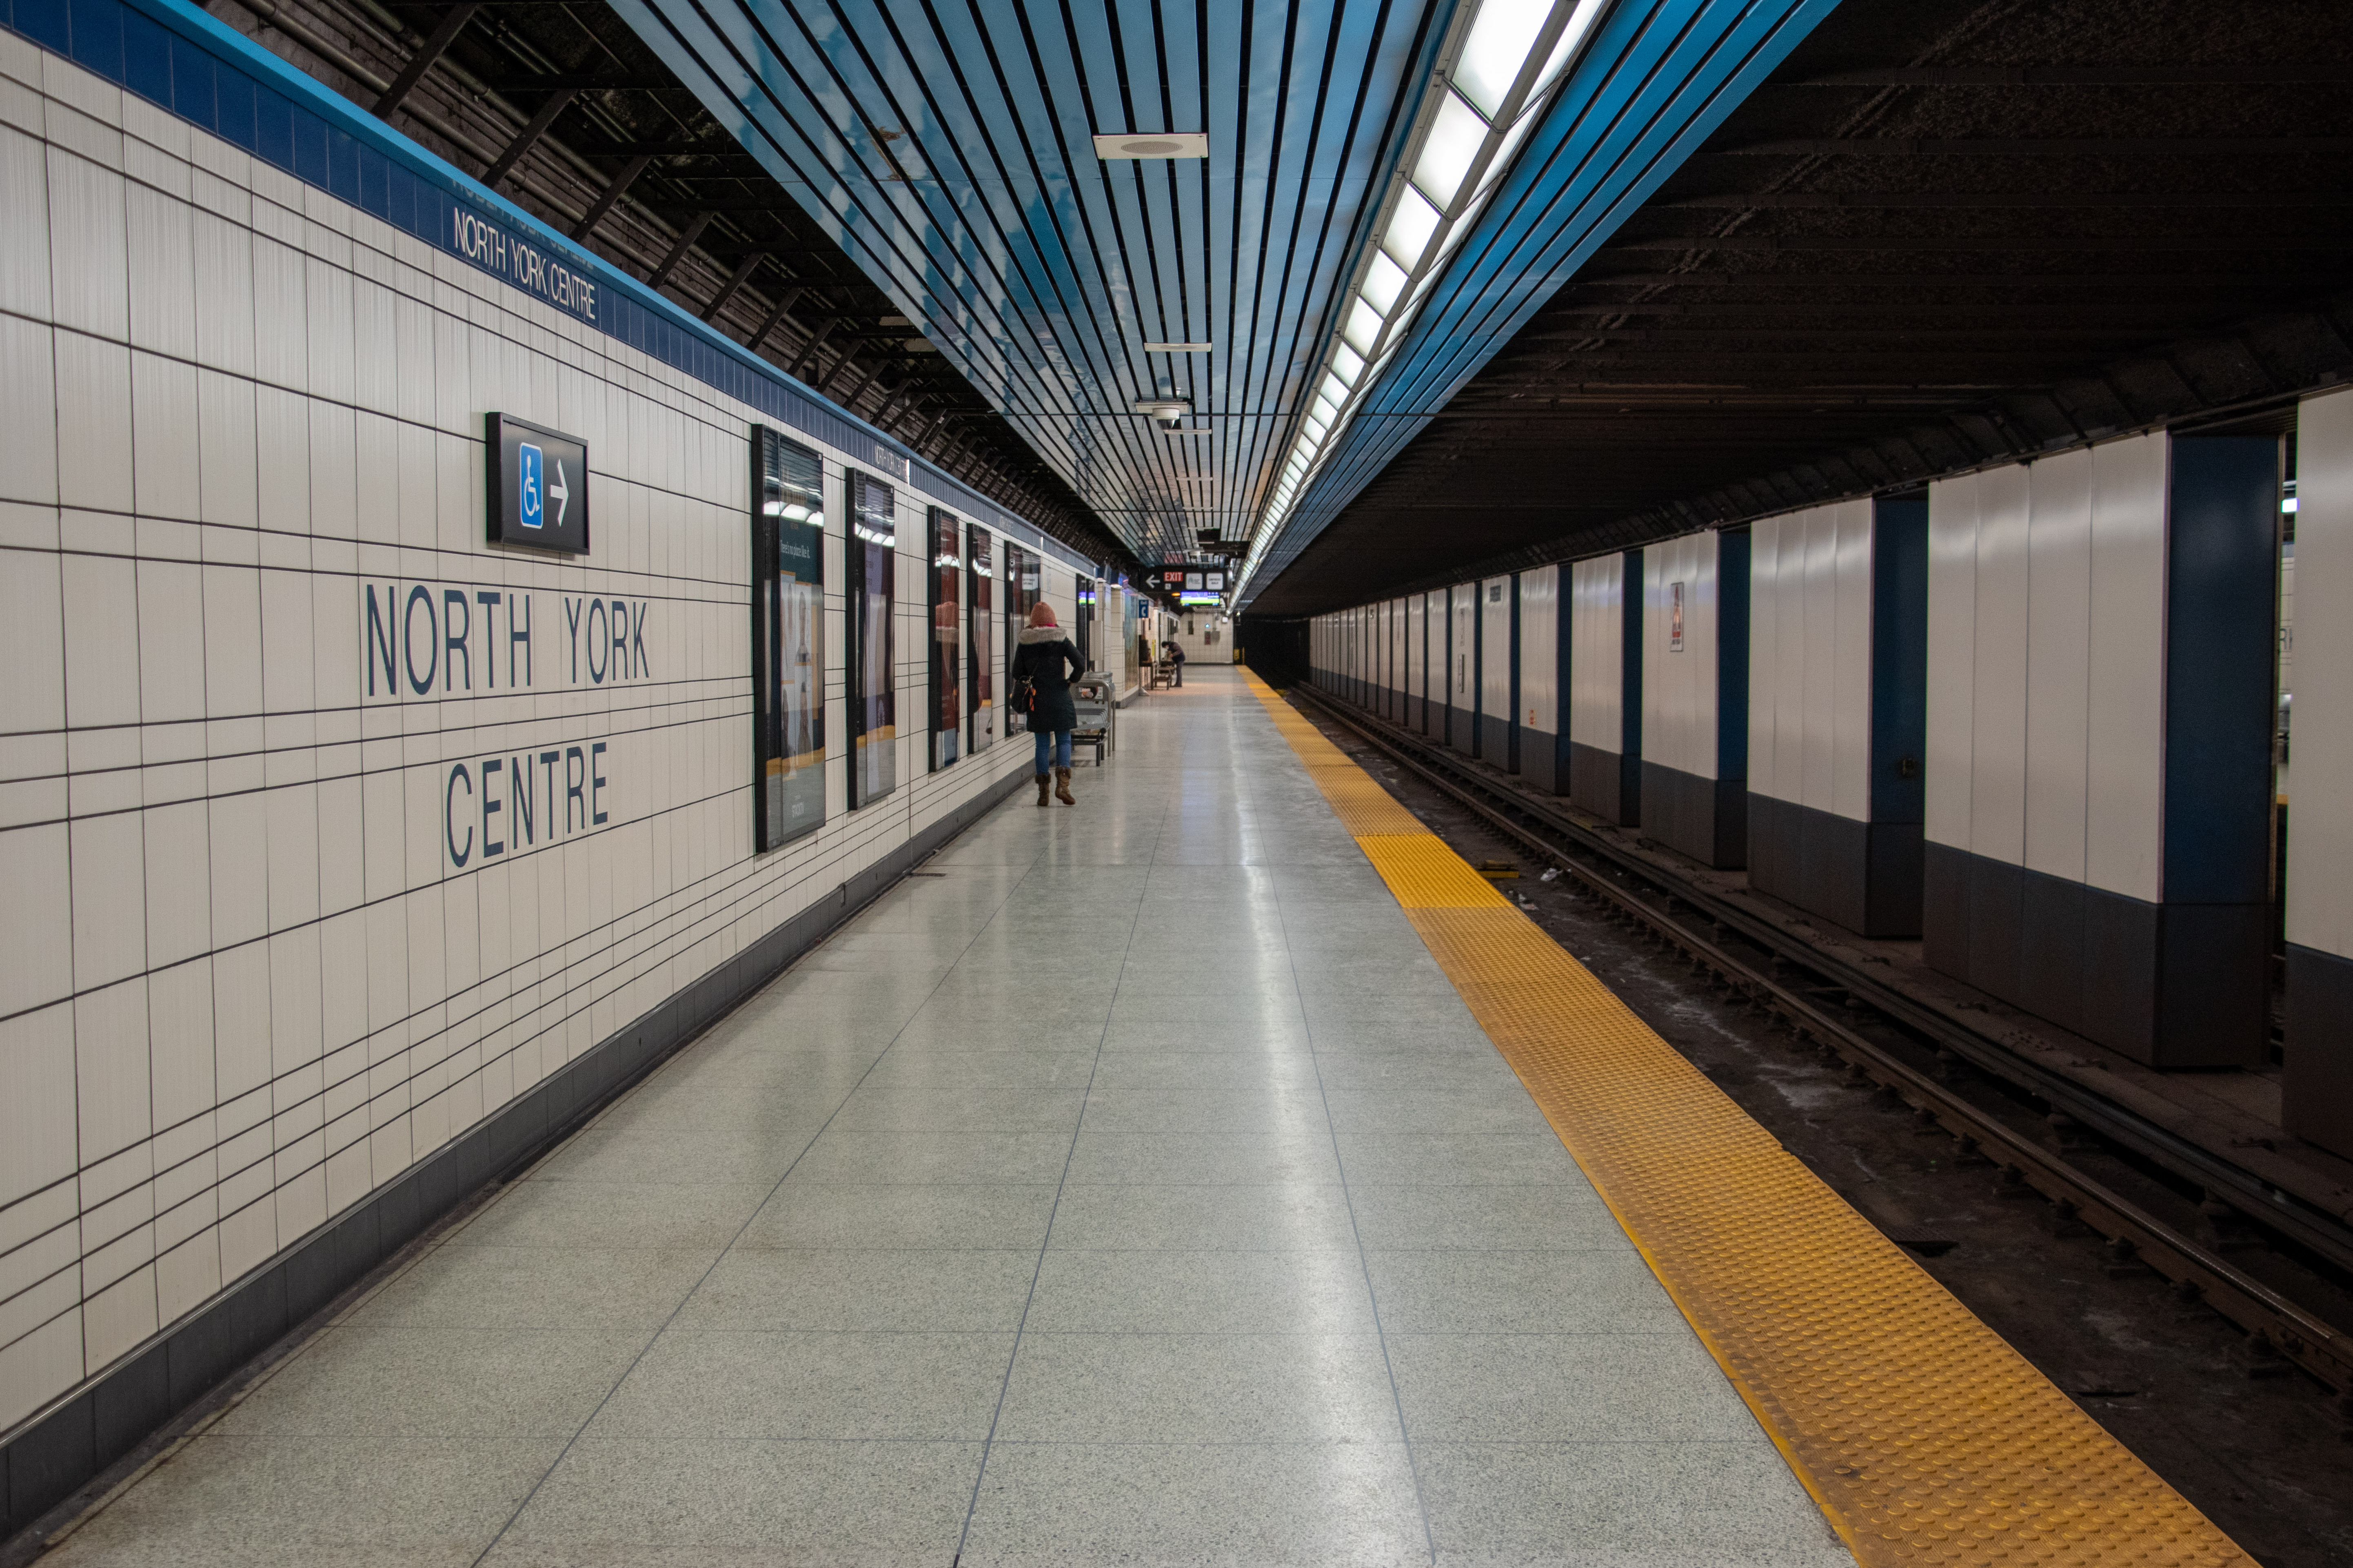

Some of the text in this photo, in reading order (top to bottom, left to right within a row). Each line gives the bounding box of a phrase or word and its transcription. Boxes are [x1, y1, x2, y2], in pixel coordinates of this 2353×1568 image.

[454, 207, 506, 272] NORTH
[511, 238, 547, 295] YORK
[551, 263, 595, 320] CENTRE
[875, 445, 886, 468] NORTH
[1165, 572, 1182, 581] EXIT
[367, 585, 649, 696] NORTH YORK
[447, 742, 608, 868] CENTRE
